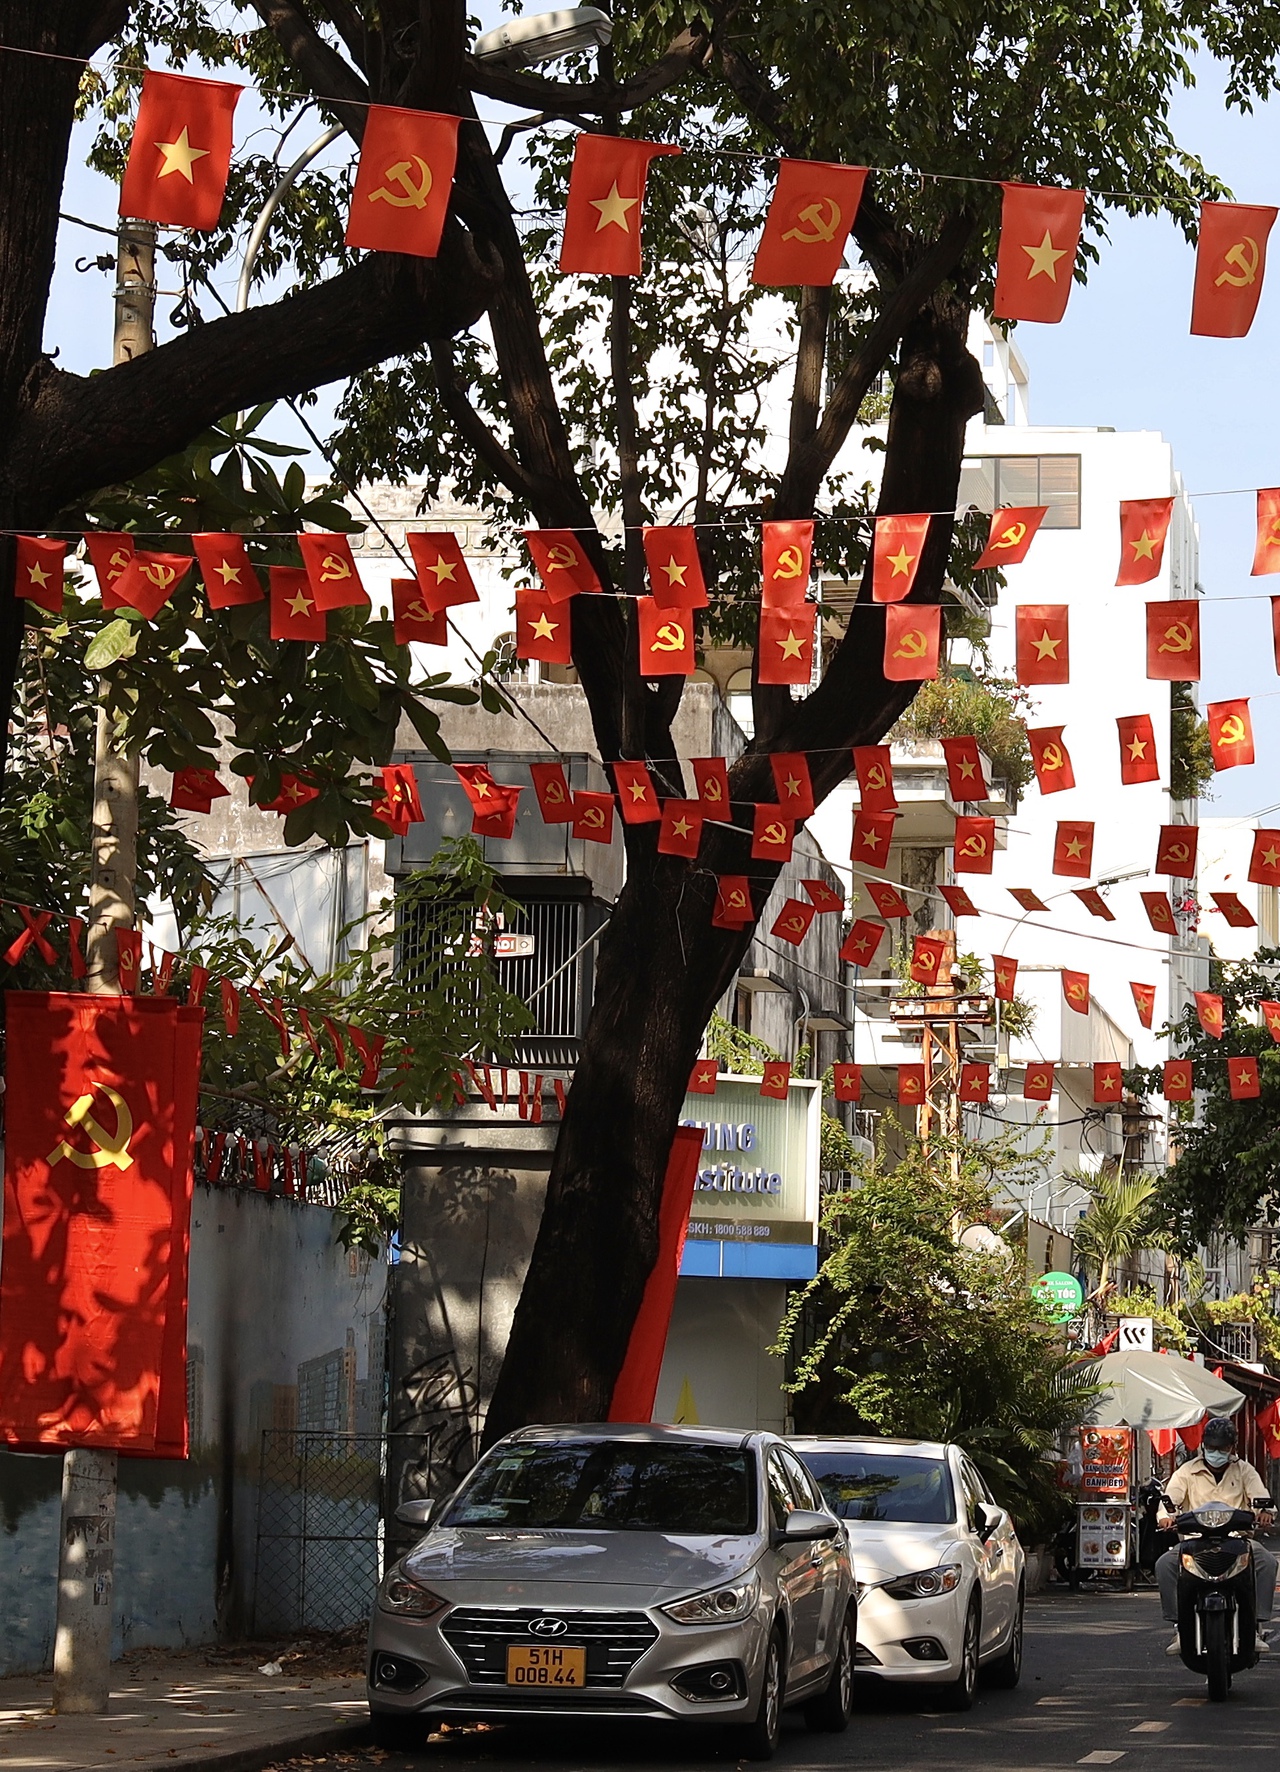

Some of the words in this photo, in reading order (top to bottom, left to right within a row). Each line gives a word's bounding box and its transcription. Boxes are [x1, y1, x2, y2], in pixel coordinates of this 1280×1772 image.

[680, 1119, 756, 1152] UNG
[693, 1162, 782, 1194] stitute
[687, 1222, 712, 1235] SKH:
[714, 1223, 735, 1235] 1800
[1057, 1288, 1076, 1299] TÓC
[529, 1648, 563, 1666] 51H
[515, 1666, 576, 1685] 008.44
